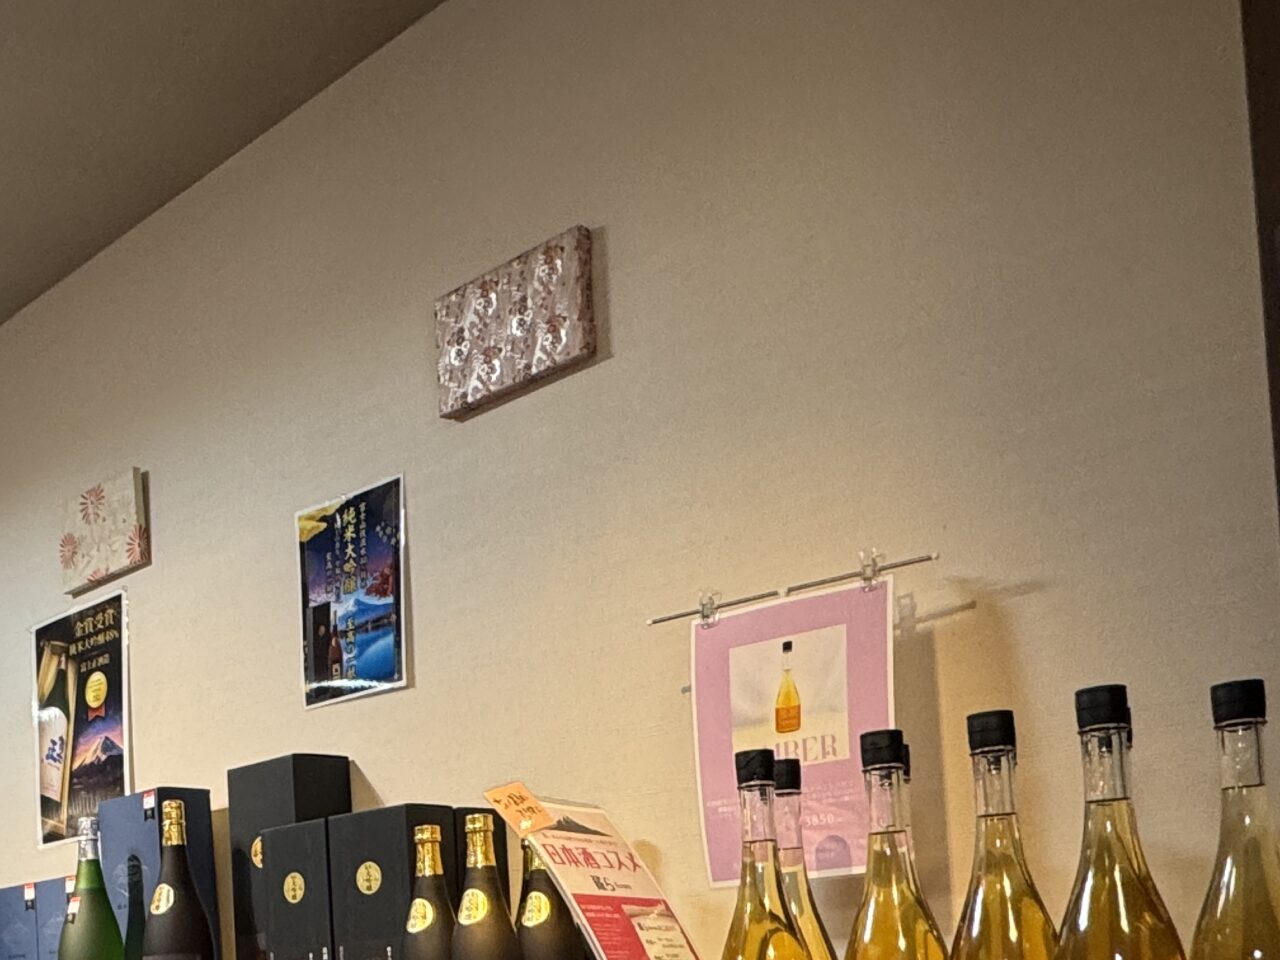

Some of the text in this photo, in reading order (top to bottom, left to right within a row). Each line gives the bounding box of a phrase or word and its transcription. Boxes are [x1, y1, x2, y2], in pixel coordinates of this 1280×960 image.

[342, 506, 357, 595] 純米大吟醸
[74, 608, 116, 639] 金賞受賞
[541, 842, 642, 873] 日本酒コスメ
